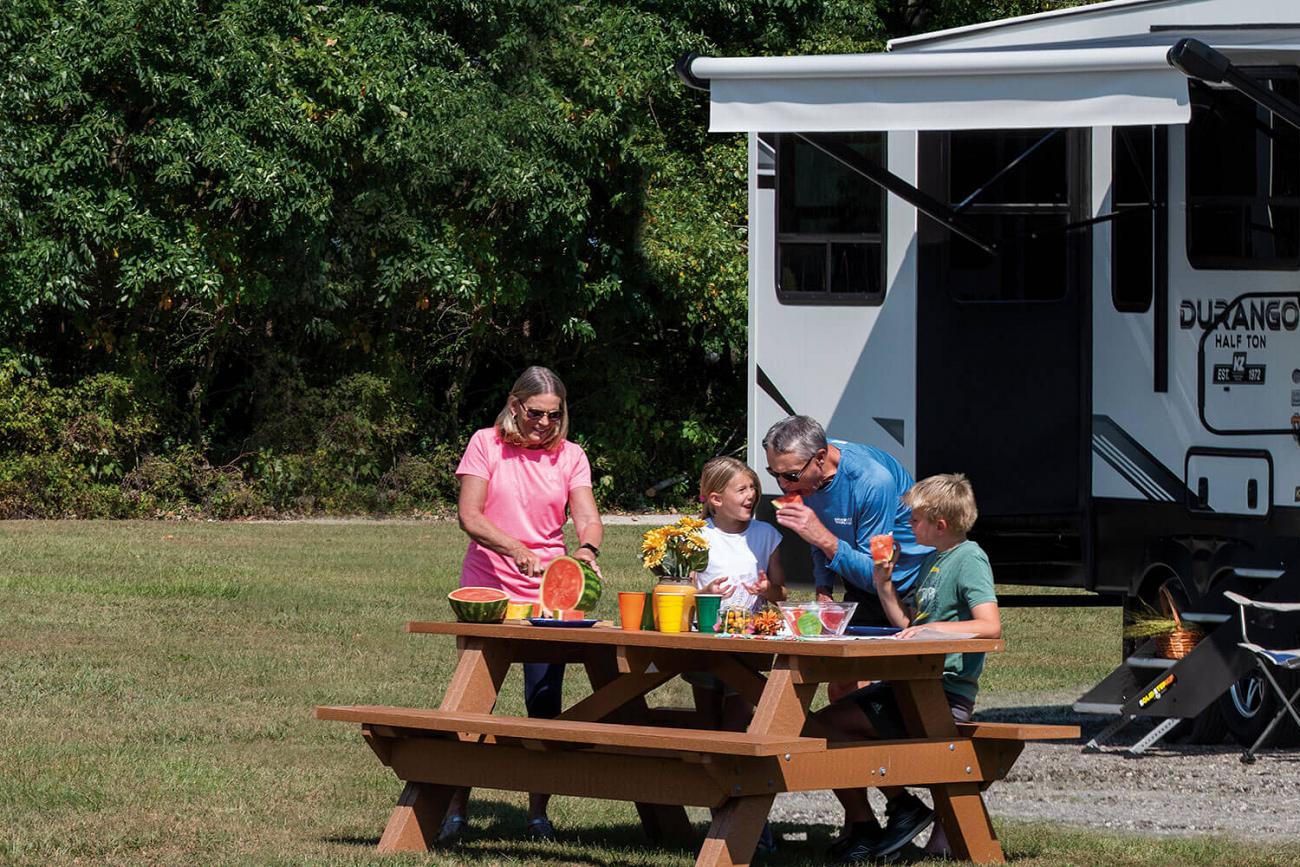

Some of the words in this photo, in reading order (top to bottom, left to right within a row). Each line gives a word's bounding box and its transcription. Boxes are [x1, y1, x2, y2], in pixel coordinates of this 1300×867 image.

[1179, 299, 1300, 331] DURANGO
[1215, 334, 1242, 349] HALF
[1246, 334, 1267, 349] TON
